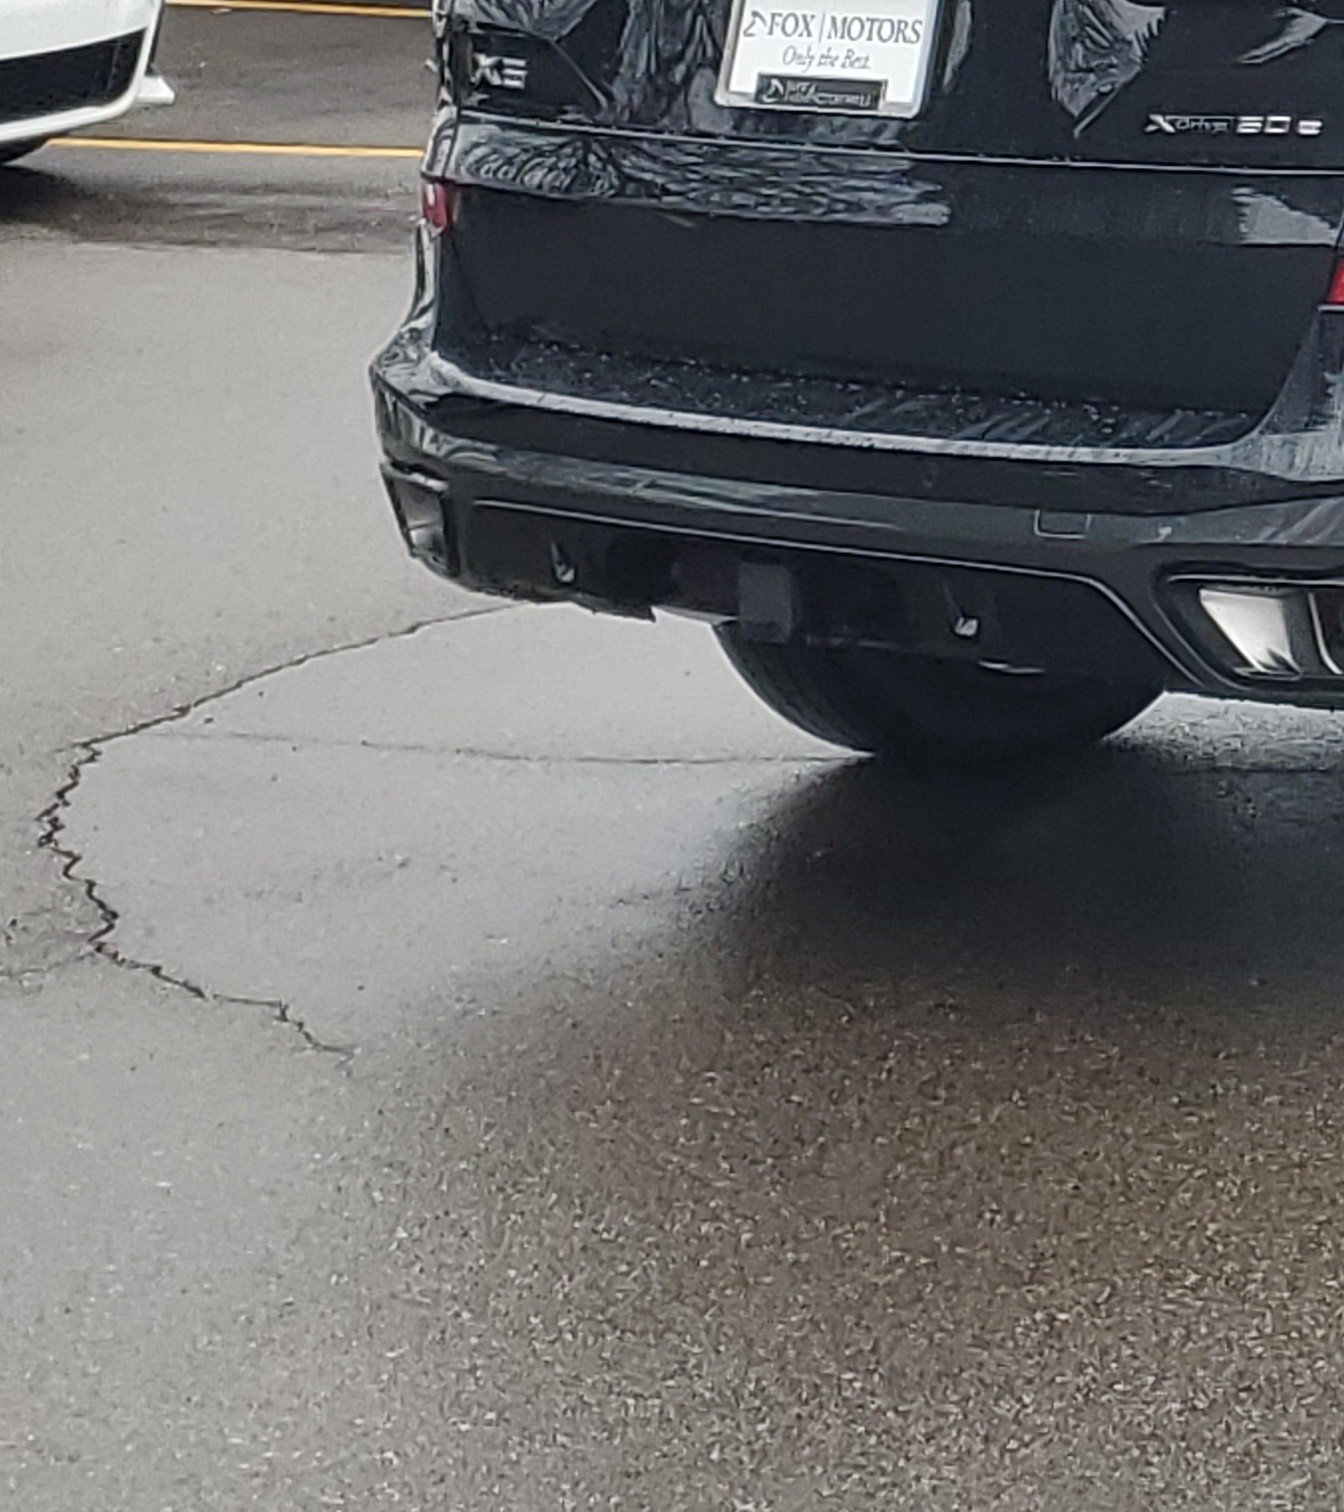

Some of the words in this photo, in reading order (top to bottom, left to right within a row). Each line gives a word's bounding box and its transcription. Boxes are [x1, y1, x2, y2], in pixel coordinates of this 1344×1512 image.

[767, 12, 816, 37] FOX
[827, 16, 923, 45] MOTORS
[469, 52, 529, 89] X5
[782, 45, 815, 73] Only
[817, 47, 839, 68] the
[841, 48, 871, 70] Best
